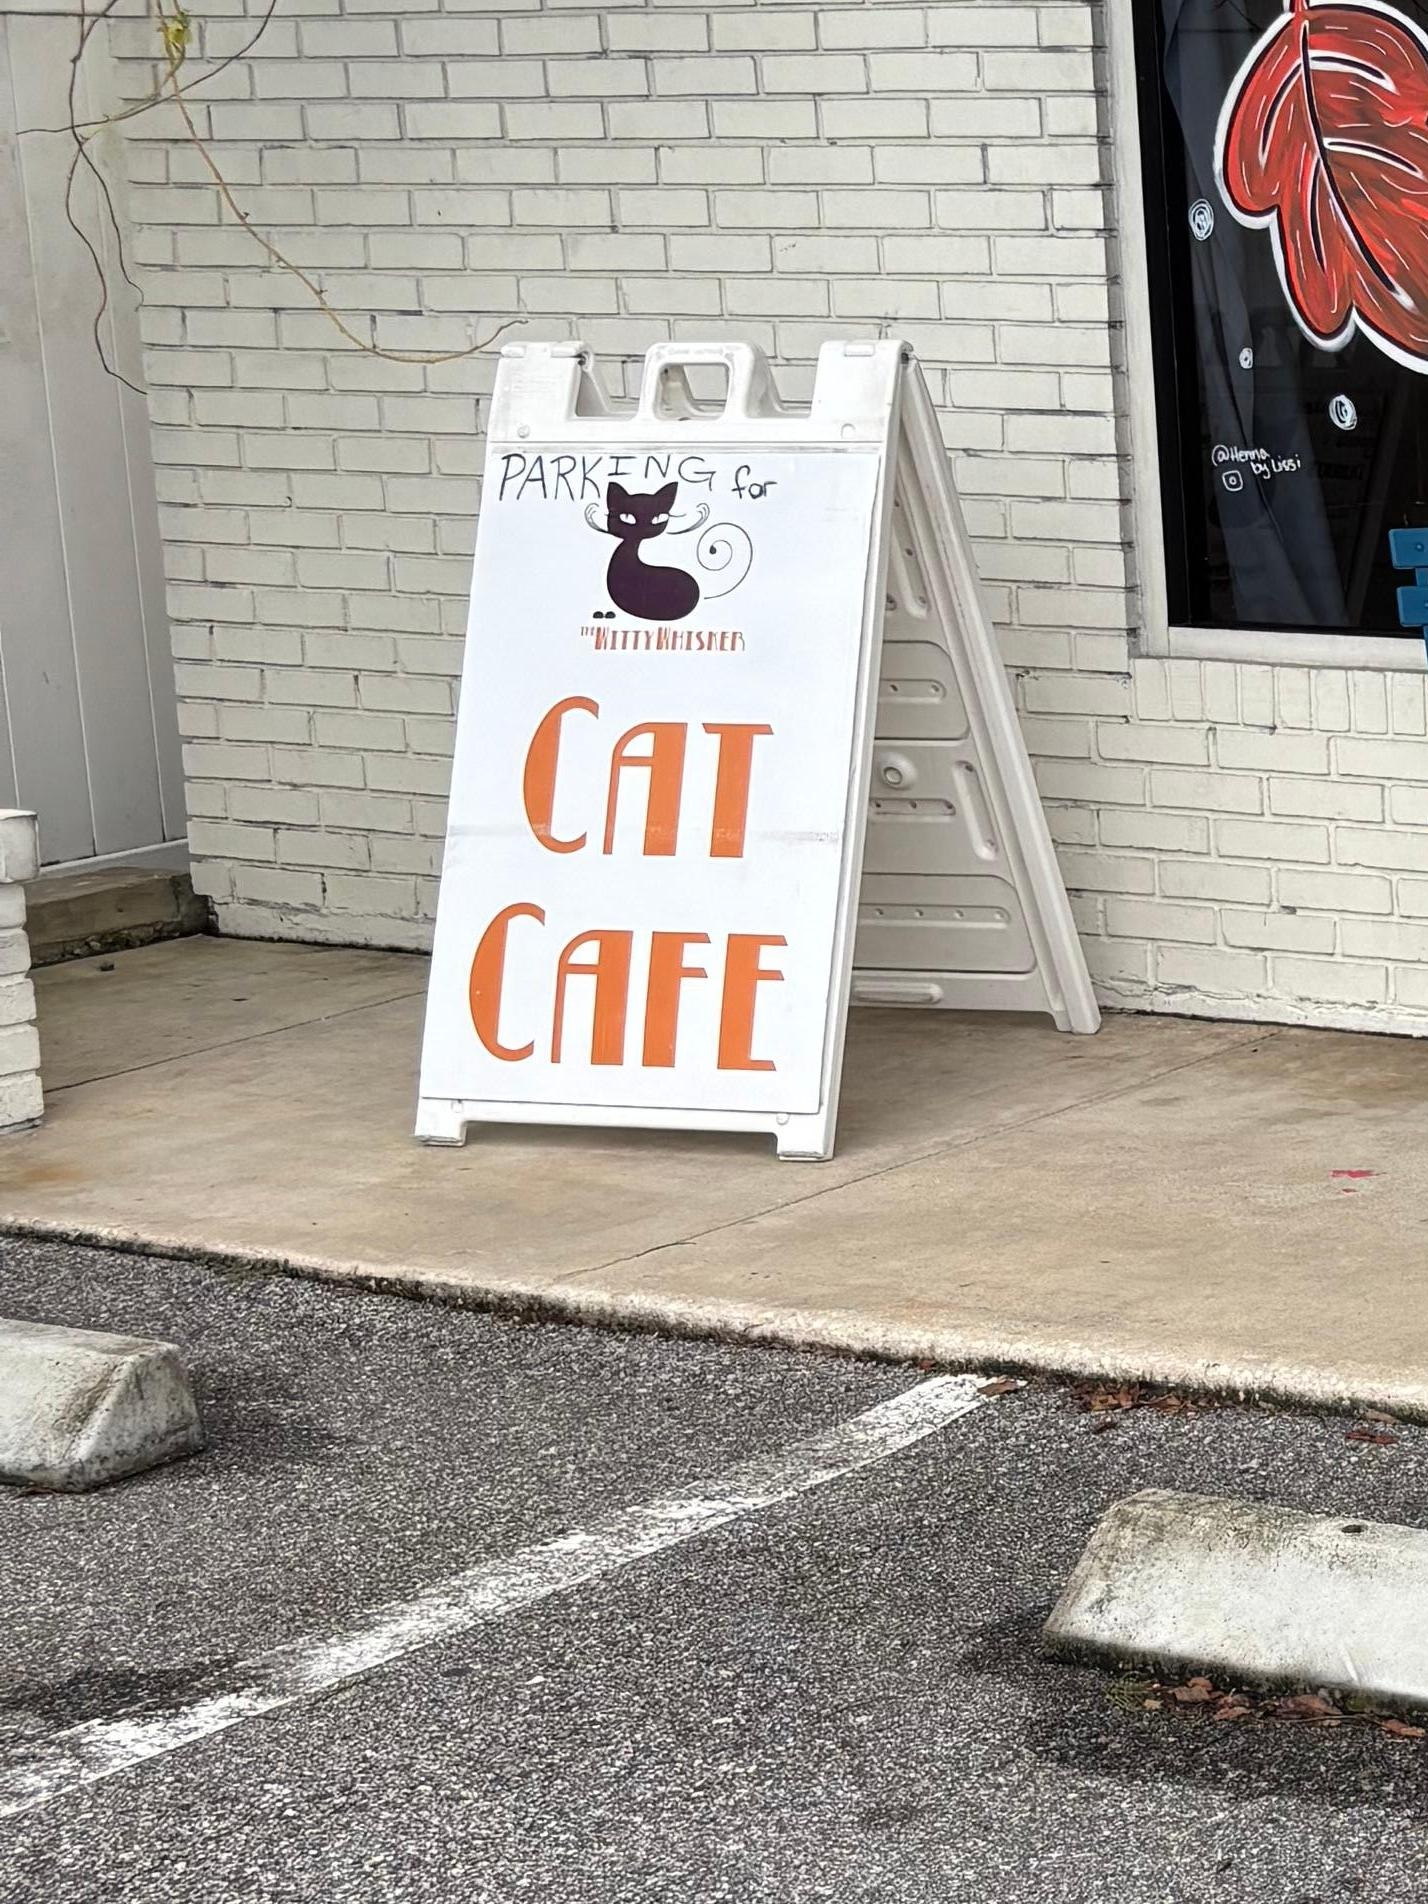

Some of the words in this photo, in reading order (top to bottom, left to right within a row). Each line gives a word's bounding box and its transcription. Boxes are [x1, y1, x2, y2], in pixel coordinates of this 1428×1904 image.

[498, 452, 718, 501] PARKING
[731, 464, 778, 500] for
[1250, 460, 1272, 480] by
[1271, 453, 1301, 473] Lissi
[522, 695, 773, 859] CAT
[467, 901, 789, 1073] CAFE
